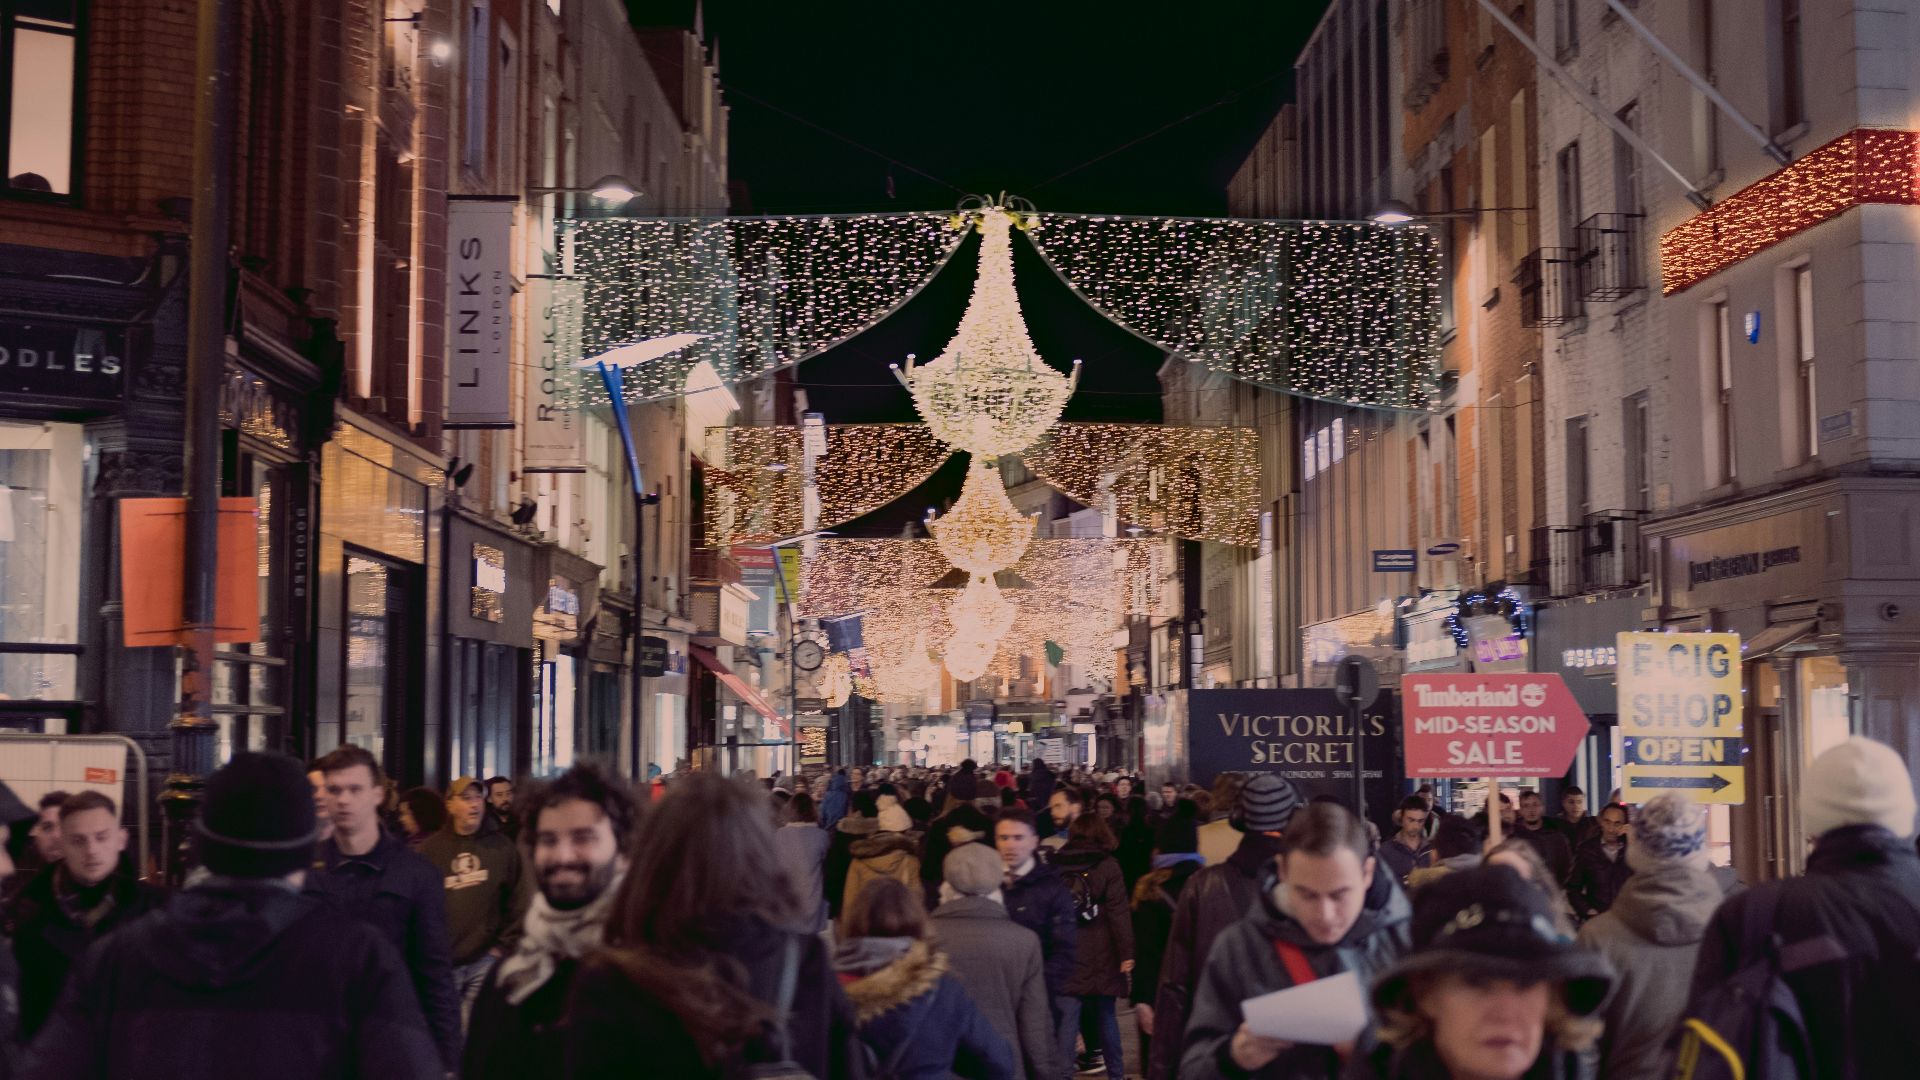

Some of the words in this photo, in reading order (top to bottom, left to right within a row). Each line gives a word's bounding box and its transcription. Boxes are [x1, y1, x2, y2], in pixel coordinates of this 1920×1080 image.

[457, 237, 482, 388] LINKS
[491, 270, 502, 355] LONDON
[537, 304, 564, 422] ROCKS
[1631, 643, 1730, 679] E-CIG
[1412, 683, 1520, 708] Timberland
[1632, 693, 1733, 728] SHOP
[1415, 716, 1556, 735] MID-SEASON
[1250, 740, 1355, 764] SECRET
[1447, 740, 1524, 765] SALE
[1637, 738, 1725, 763] OPEN
